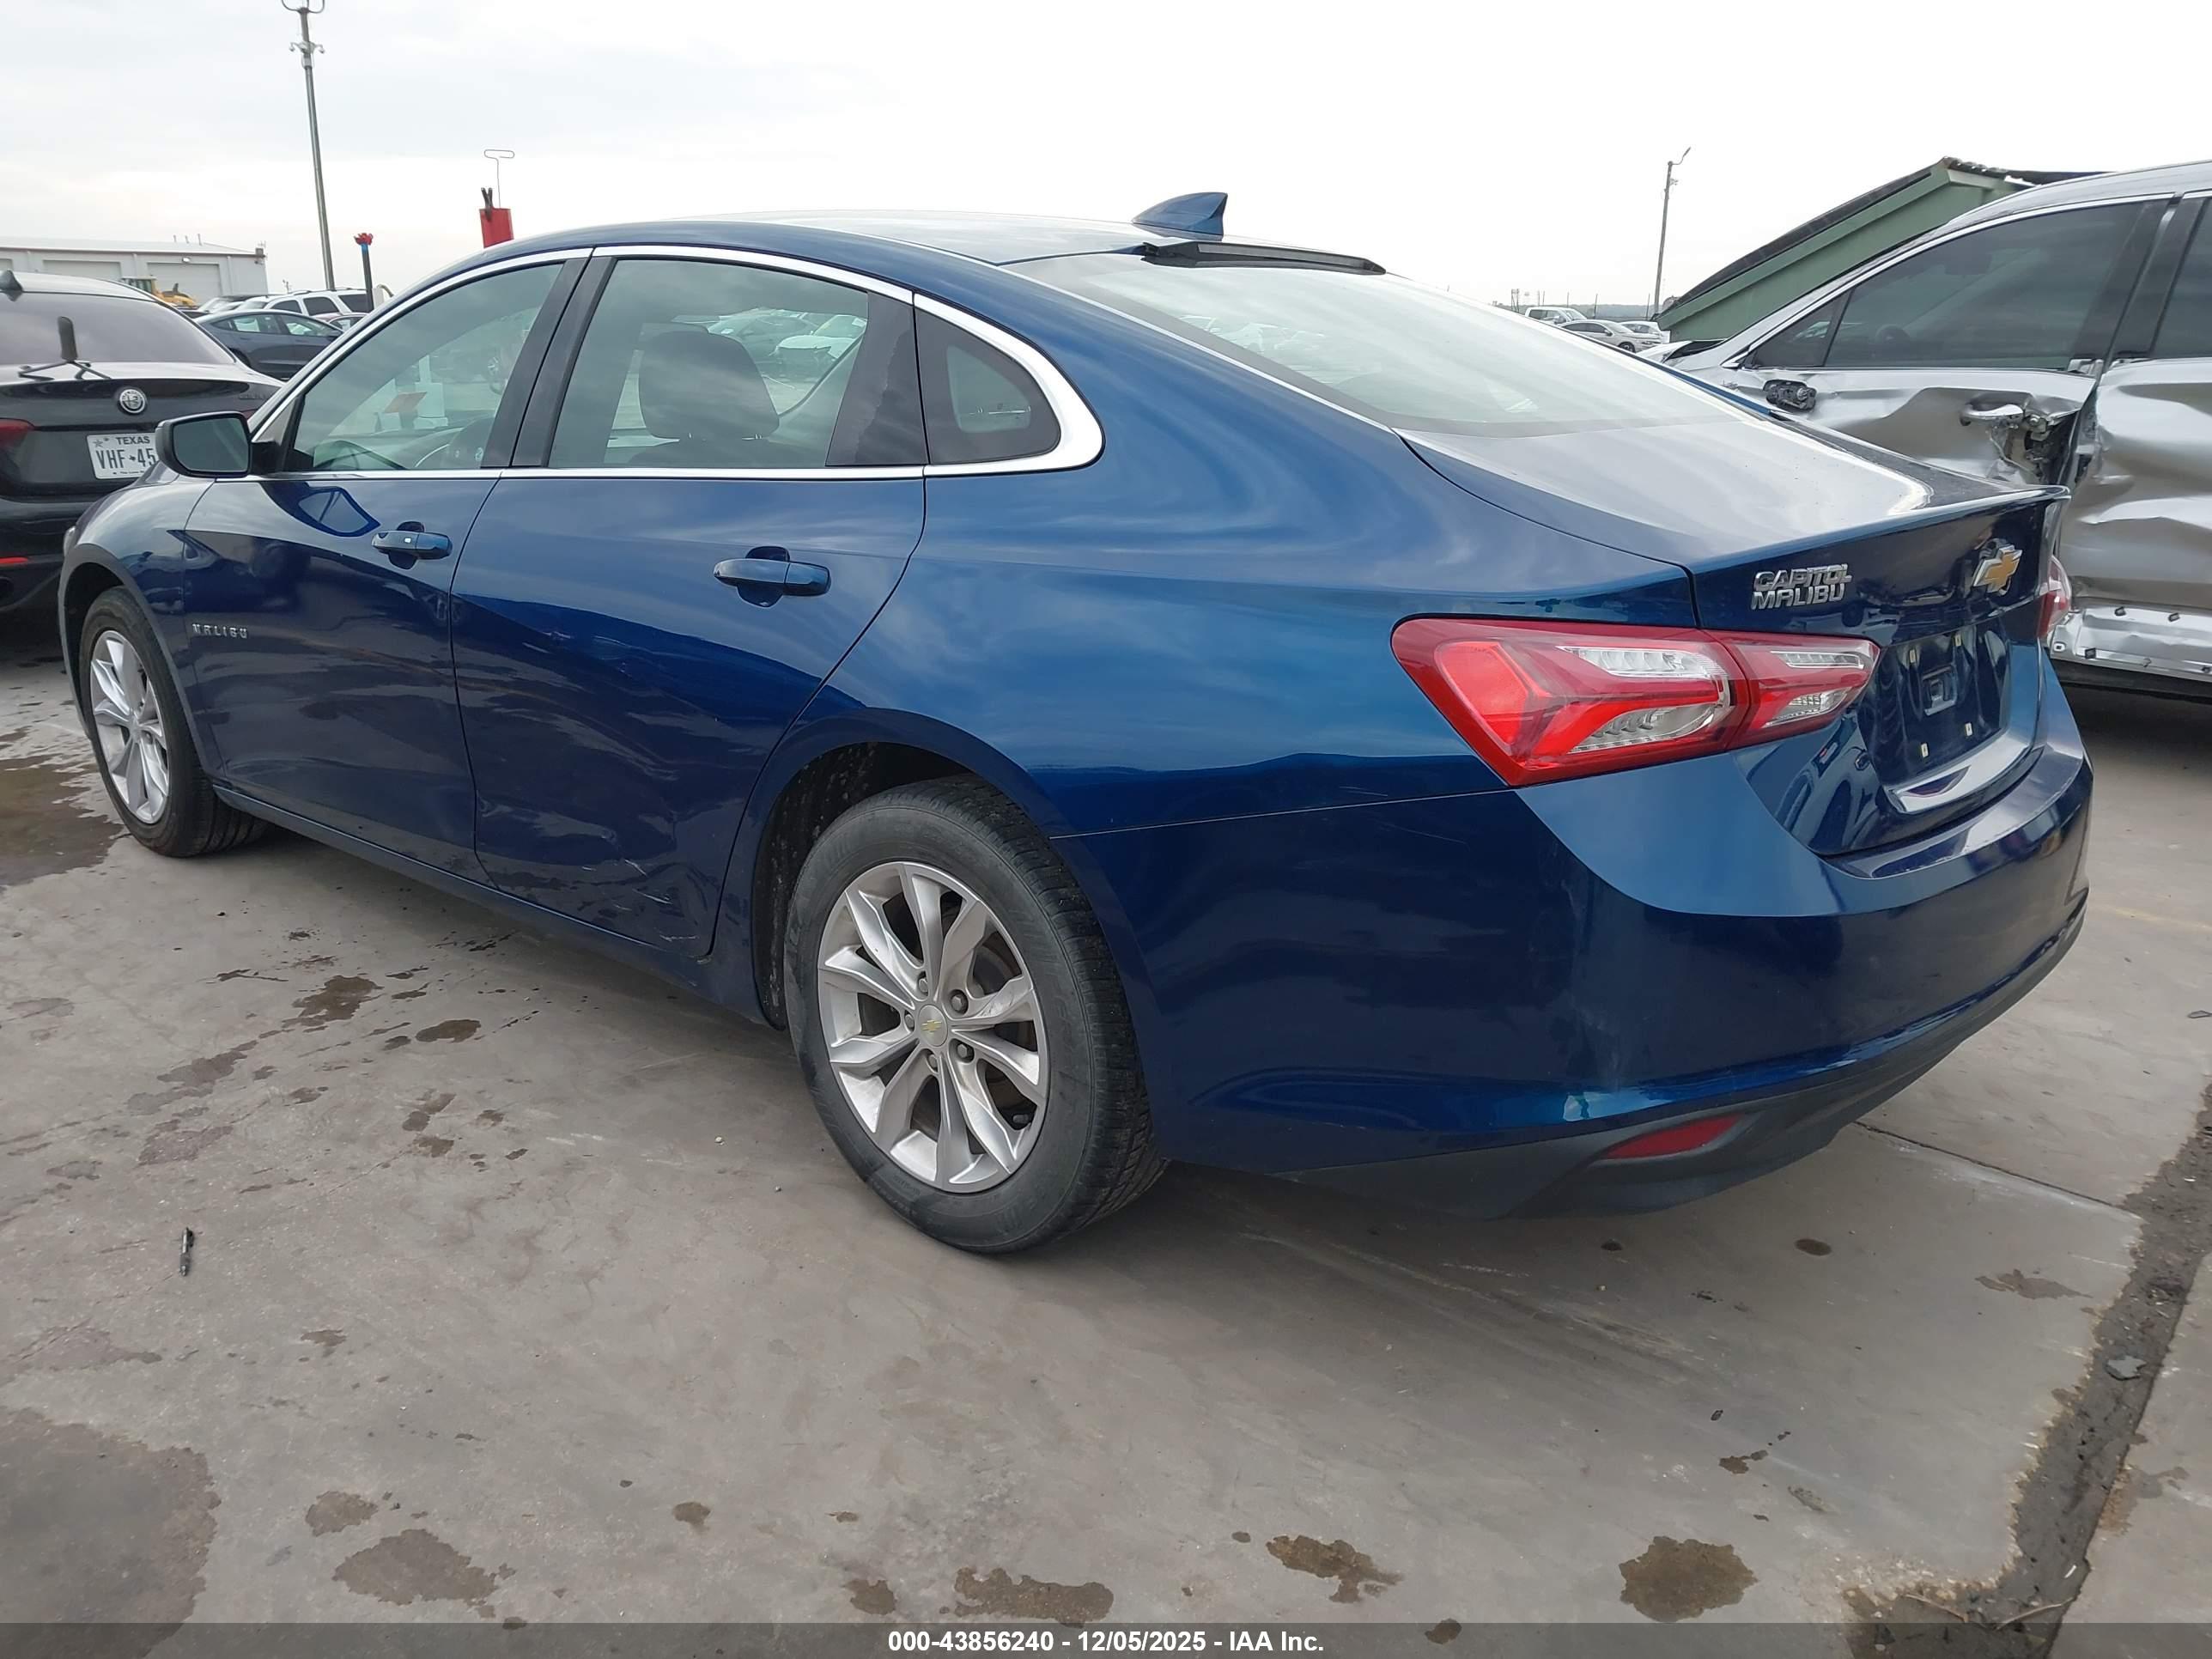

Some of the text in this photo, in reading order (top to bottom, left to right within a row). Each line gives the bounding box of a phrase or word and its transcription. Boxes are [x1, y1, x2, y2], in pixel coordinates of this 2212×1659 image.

[115, 435, 151, 446] TEXAS
[95, 449, 125, 470] VHF
[1753, 563, 1852, 592] CAPITOL
[1751, 583, 1845, 611] MALIBU
[191, 623, 248, 639] MALIBU
